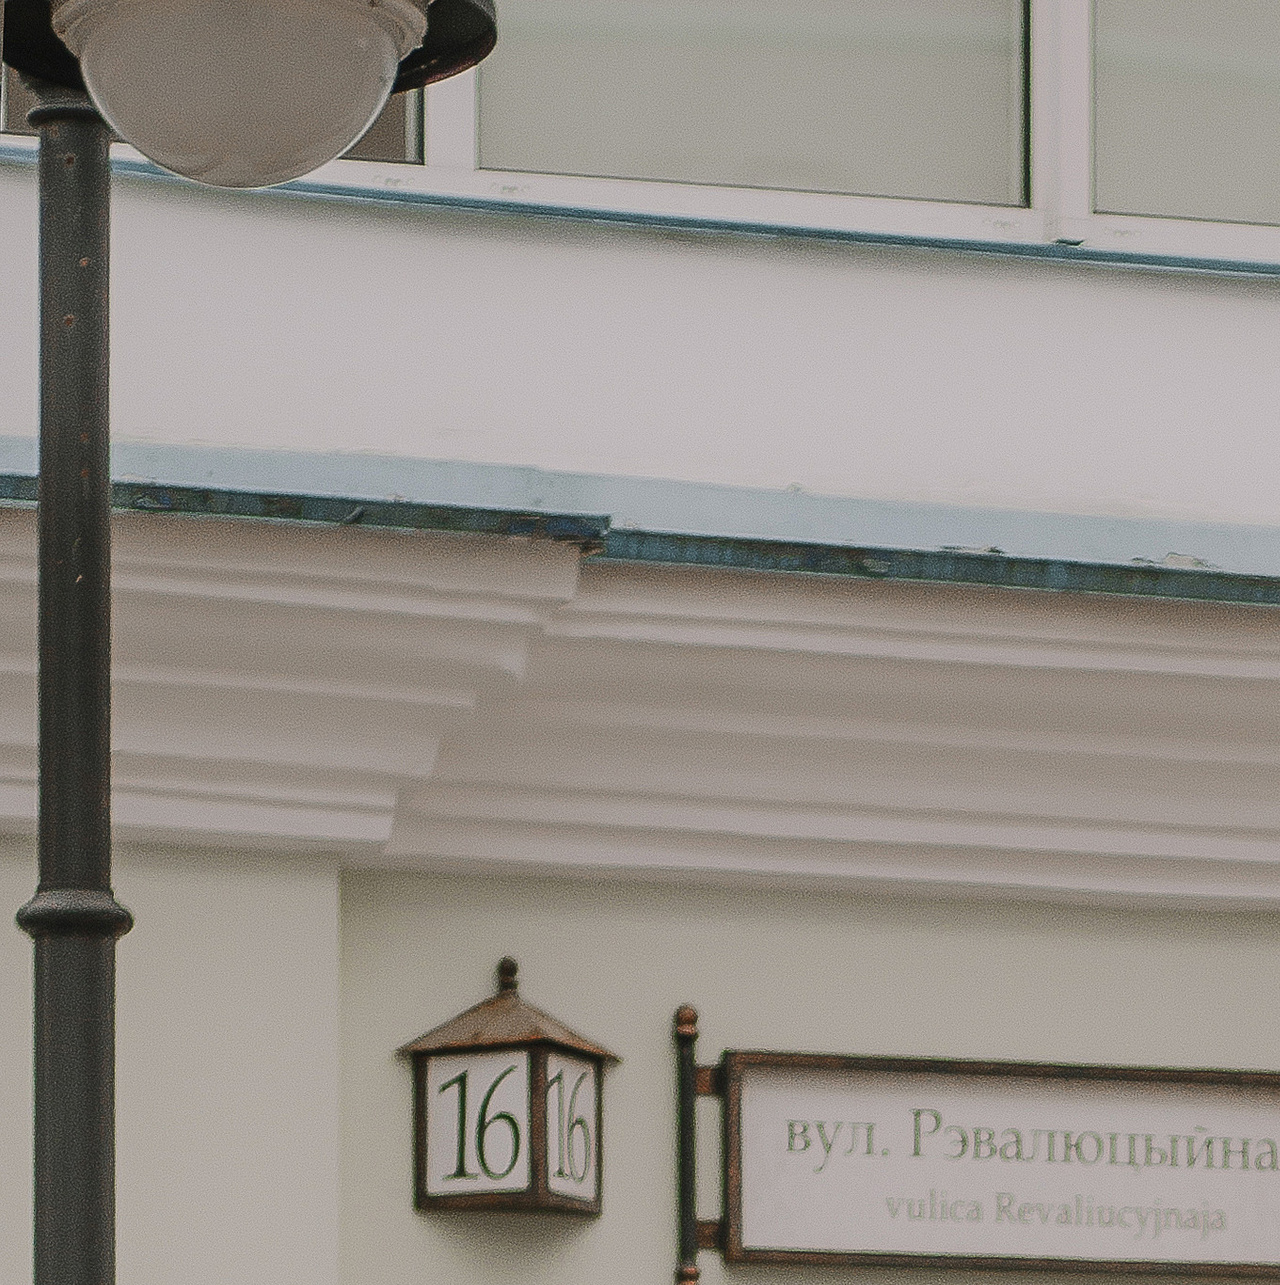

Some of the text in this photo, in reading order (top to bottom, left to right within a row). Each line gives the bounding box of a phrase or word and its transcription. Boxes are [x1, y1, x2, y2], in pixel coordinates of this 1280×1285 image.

[438, 1064, 520, 1181] 16
[547, 1069, 591, 1183] 16
[786, 1119, 890, 1174] вул.
[885, 1188, 1228, 1240] vulica Revaliucyjnaja
